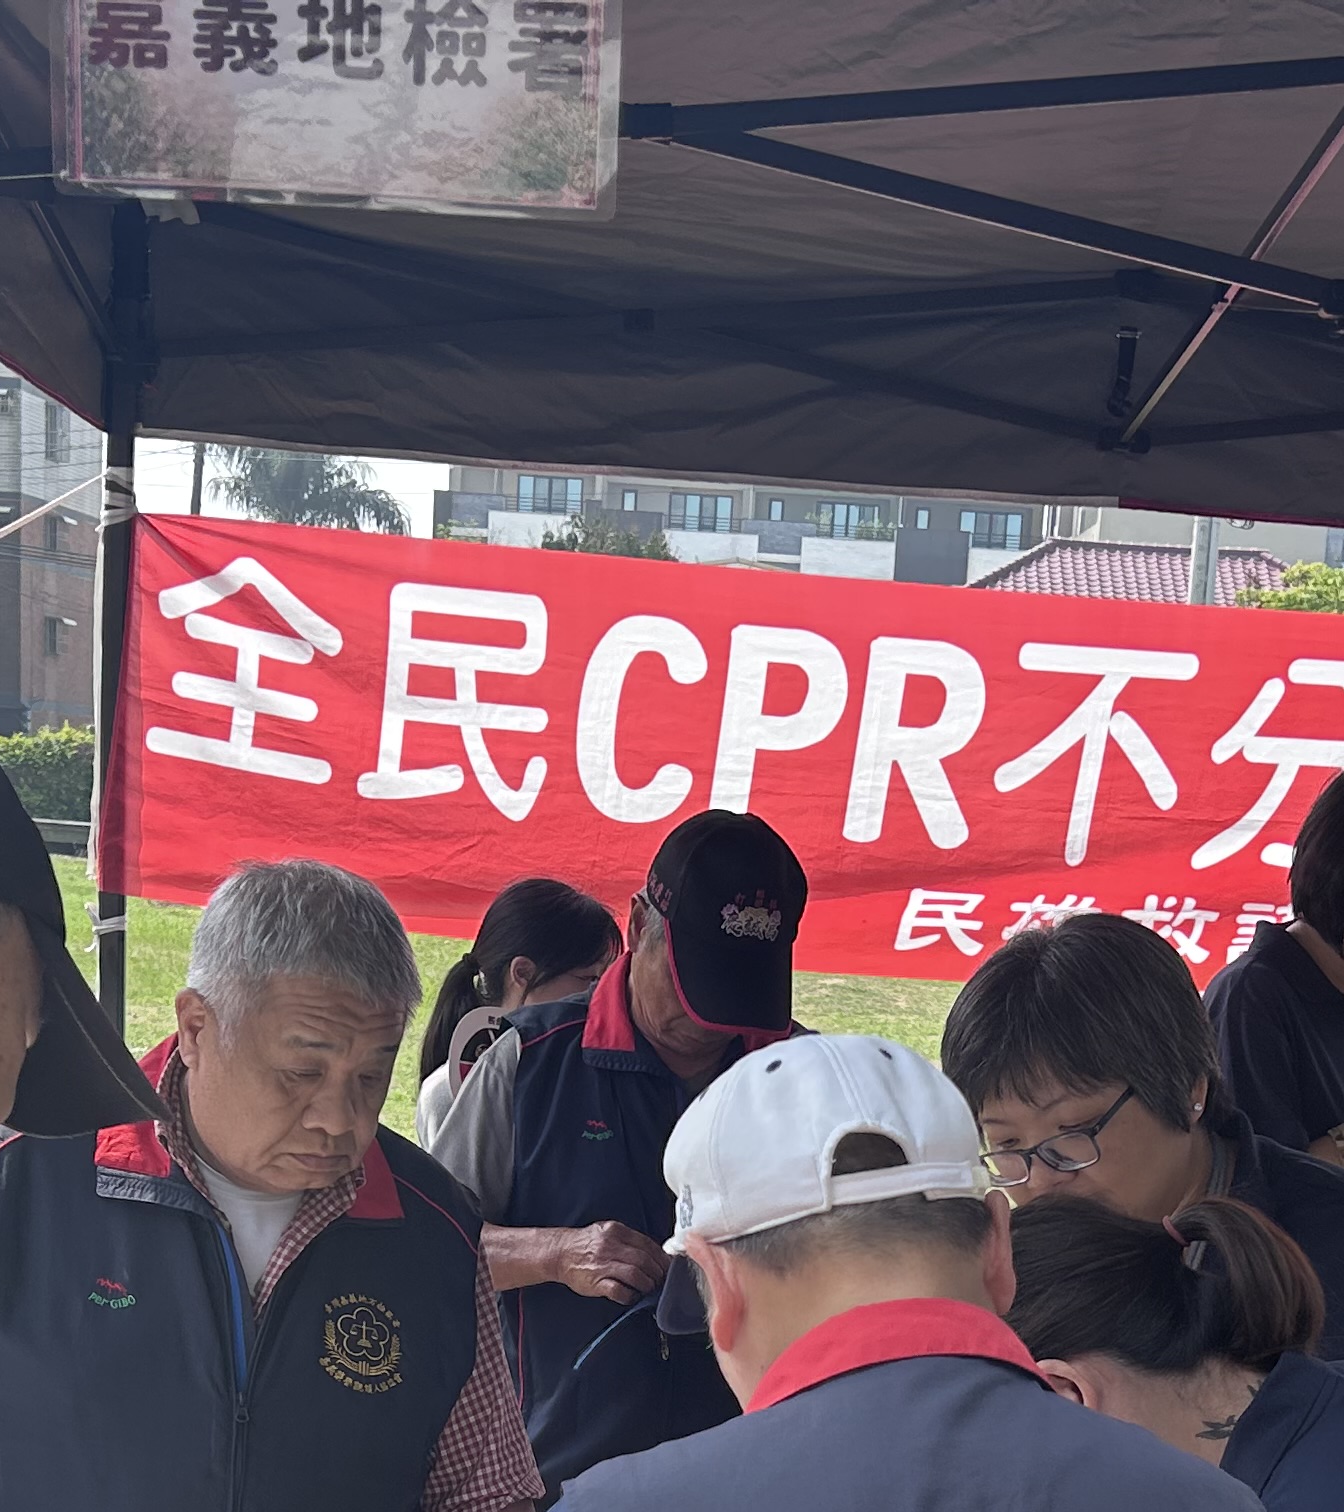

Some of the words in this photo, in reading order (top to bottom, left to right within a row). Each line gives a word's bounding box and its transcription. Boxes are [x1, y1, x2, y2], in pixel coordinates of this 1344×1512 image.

[88, 0, 590, 95] 嘉義地檢署
